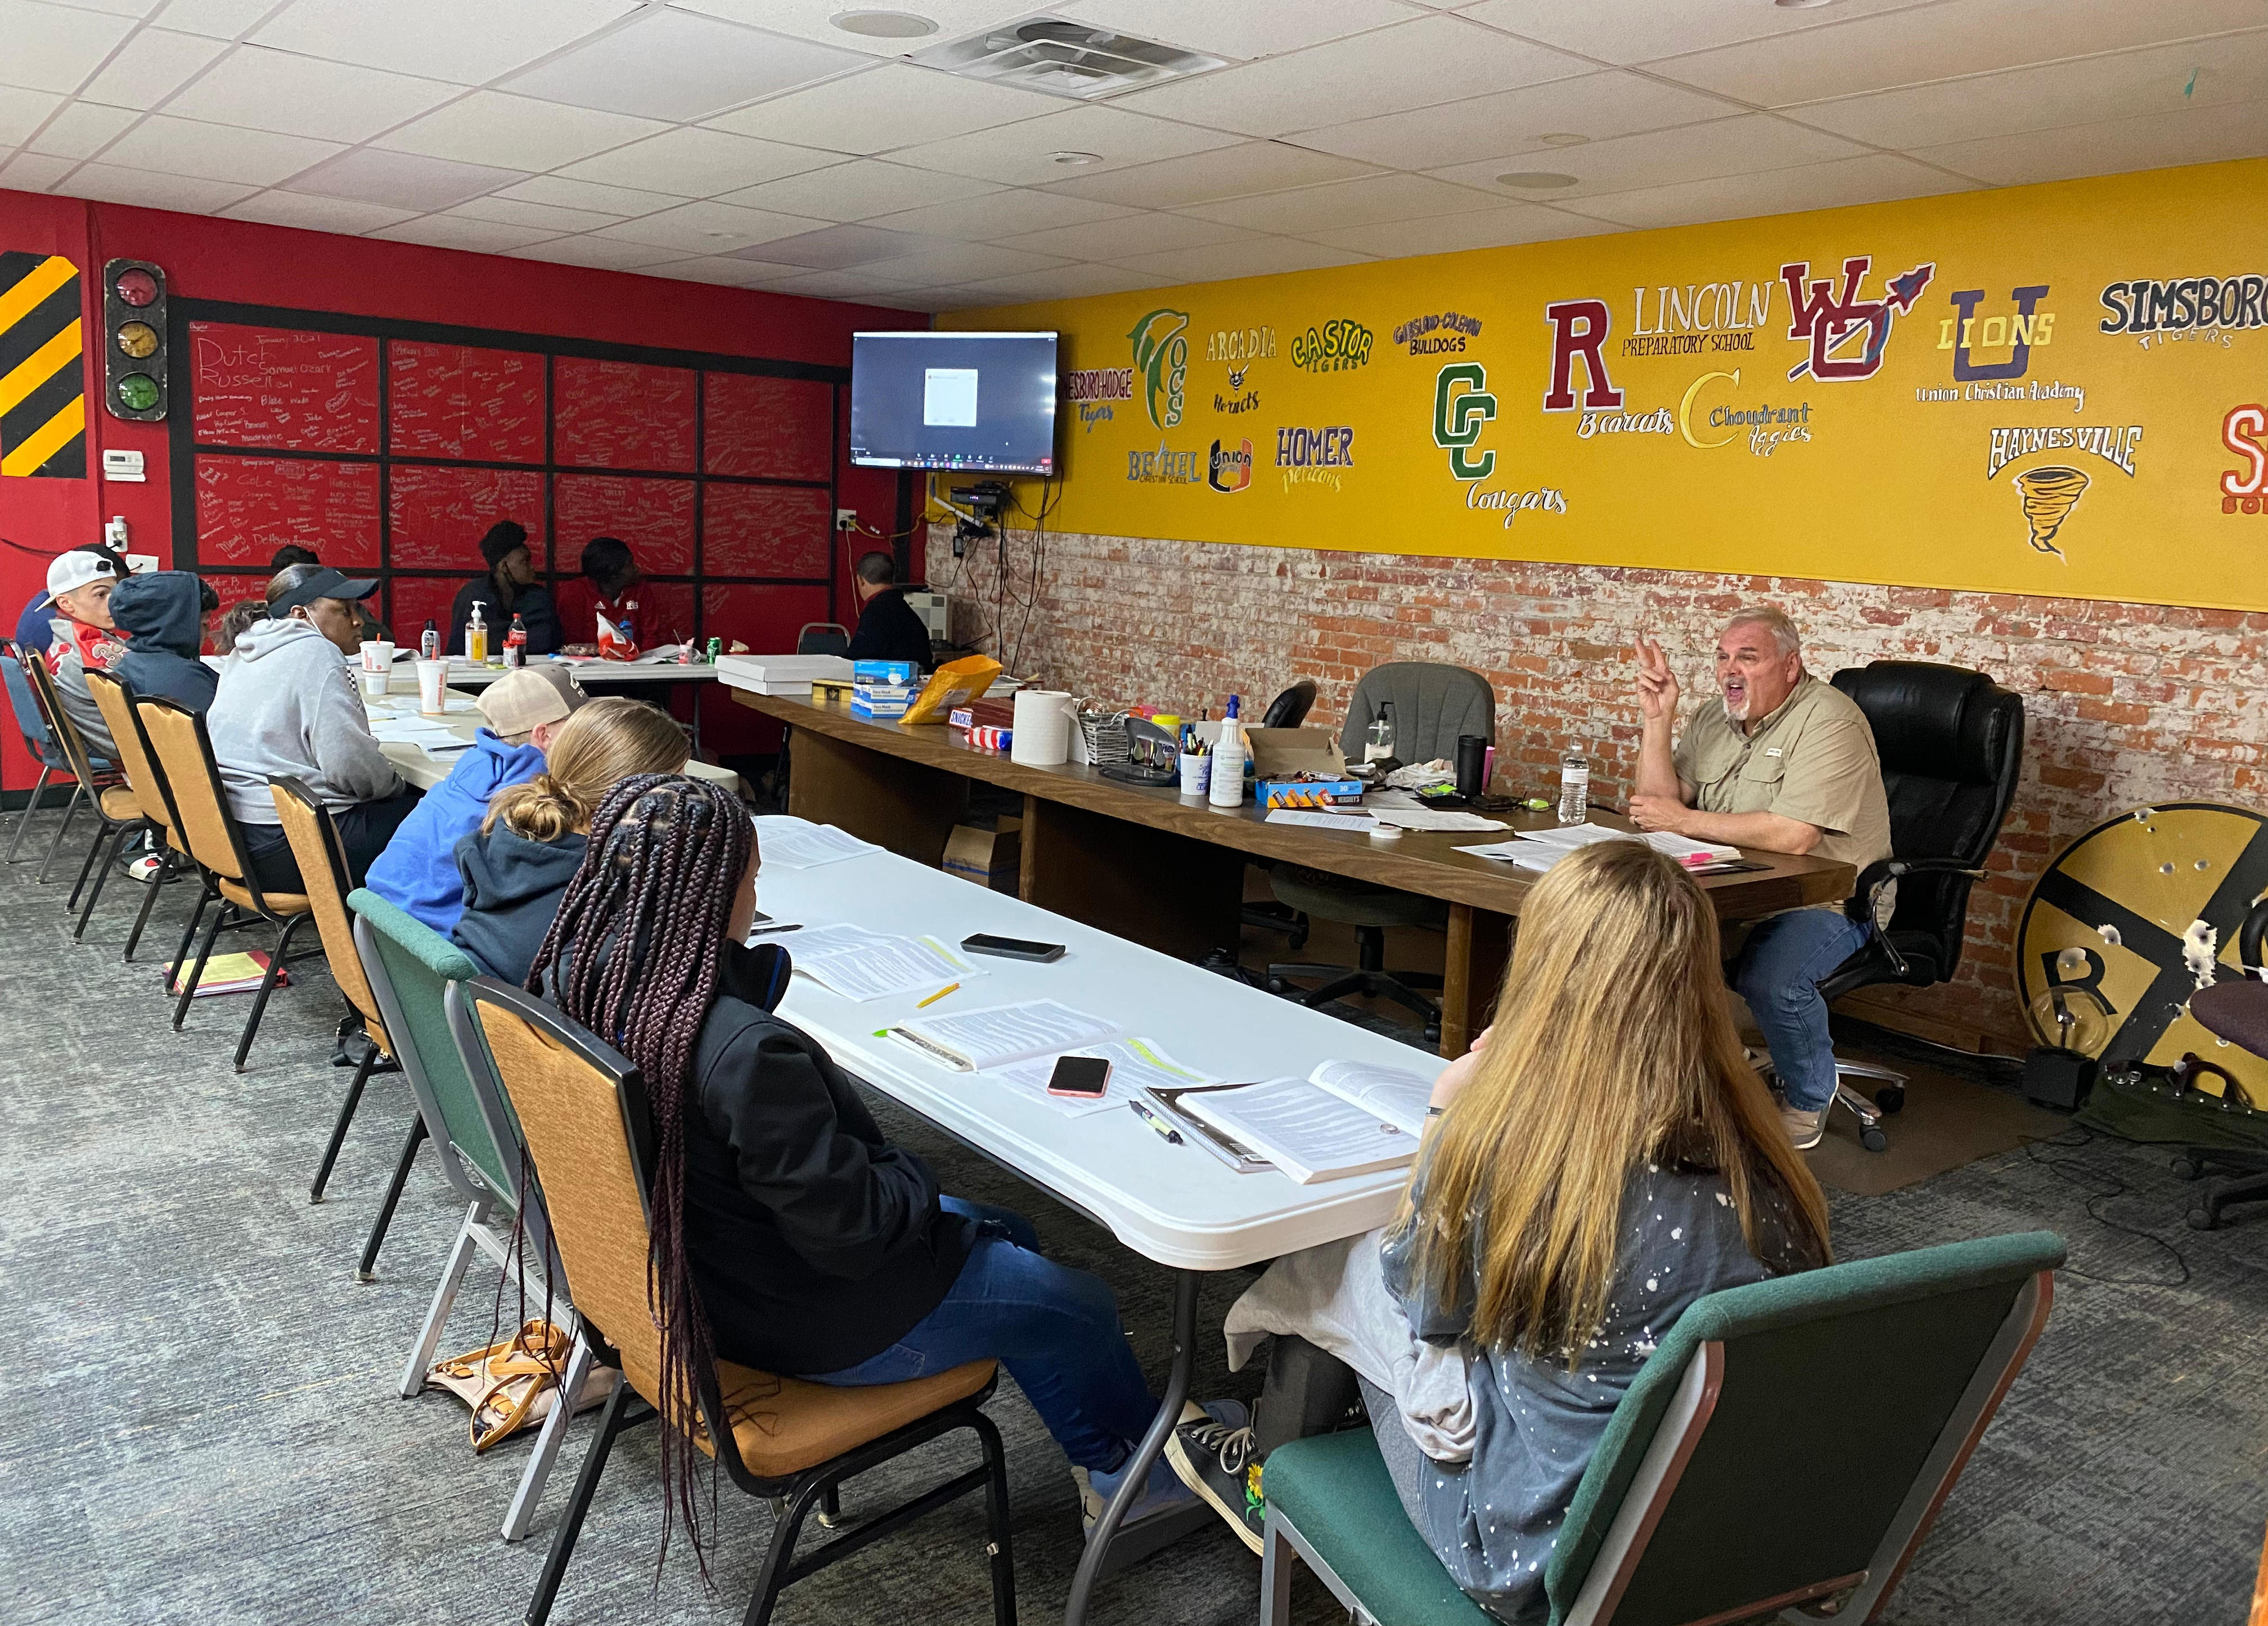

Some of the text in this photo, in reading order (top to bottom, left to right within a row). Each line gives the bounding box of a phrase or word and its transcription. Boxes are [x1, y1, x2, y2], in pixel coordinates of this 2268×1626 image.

[1633, 281, 1774, 335] LINCOLN
[1205, 326, 1277, 361] ARCADIA
[1291, 319, 1374, 368] CASTOR
[1409, 336, 1466, 356] BULLDOGS
[1621, 332, 1756, 357] PREPARATORY SCHOOL
[1936, 313, 2056, 349] LIONS
[1951, 285, 2050, 382] U
[2139, 327, 2234, 351] TIGERS
[197, 337, 277, 367] Dutch
[300, 363, 332, 374] Ozark
[1306, 358, 1358, 372] TIGERS
[1542, 299, 1625, 412] R
[199, 367, 272, 388] Russell
[1214, 391, 1261, 414] Hornets
[1679, 367, 1741, 449] C
[1915, 380, 2085, 414] Union Christian Academy
[1576, 406, 1675, 439] Bearcats
[1709, 402, 1814, 428] Choudrant
[1275, 426, 1354, 468] HOMER
[1747, 424, 1814, 457] Aggies
[1987, 425, 2144, 480] HAYNESVILLE
[2220, 403, 2268, 498] S
[1466, 481, 1569, 529] Cougars
[2041, 946, 2118, 1016] R
